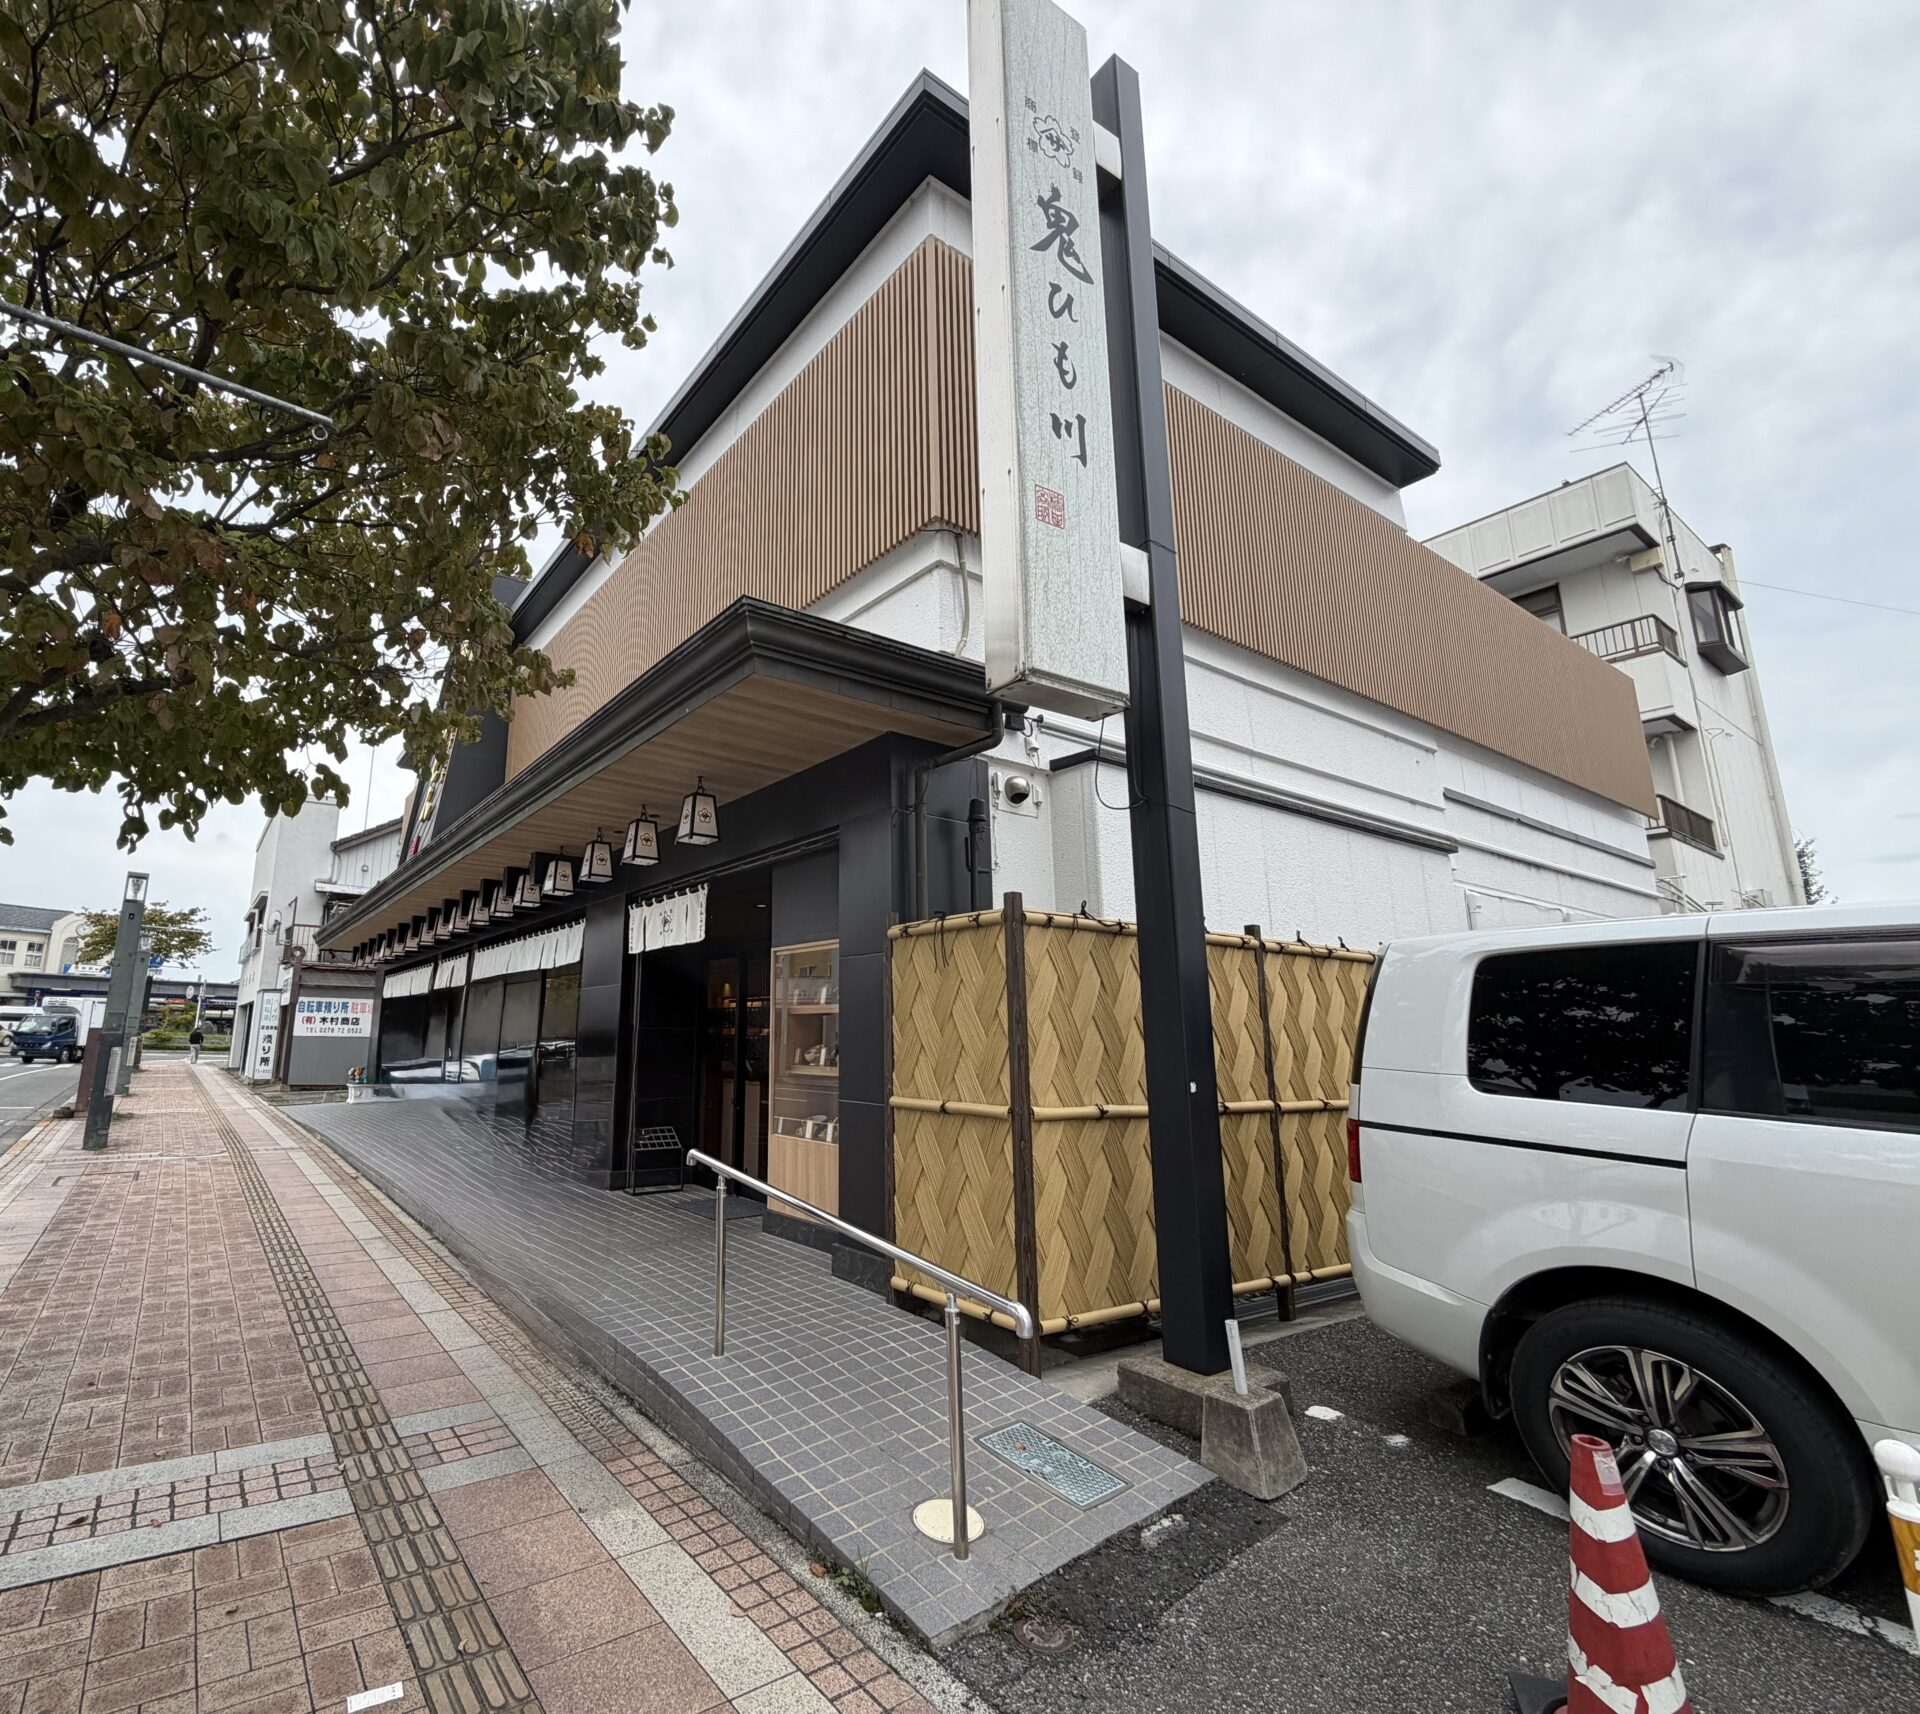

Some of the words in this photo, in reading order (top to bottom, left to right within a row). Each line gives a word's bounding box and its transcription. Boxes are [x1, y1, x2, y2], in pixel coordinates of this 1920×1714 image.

[1029, 184, 1094, 468] 鬼ひも川
[319, 1016, 360, 1026] 木村商店
